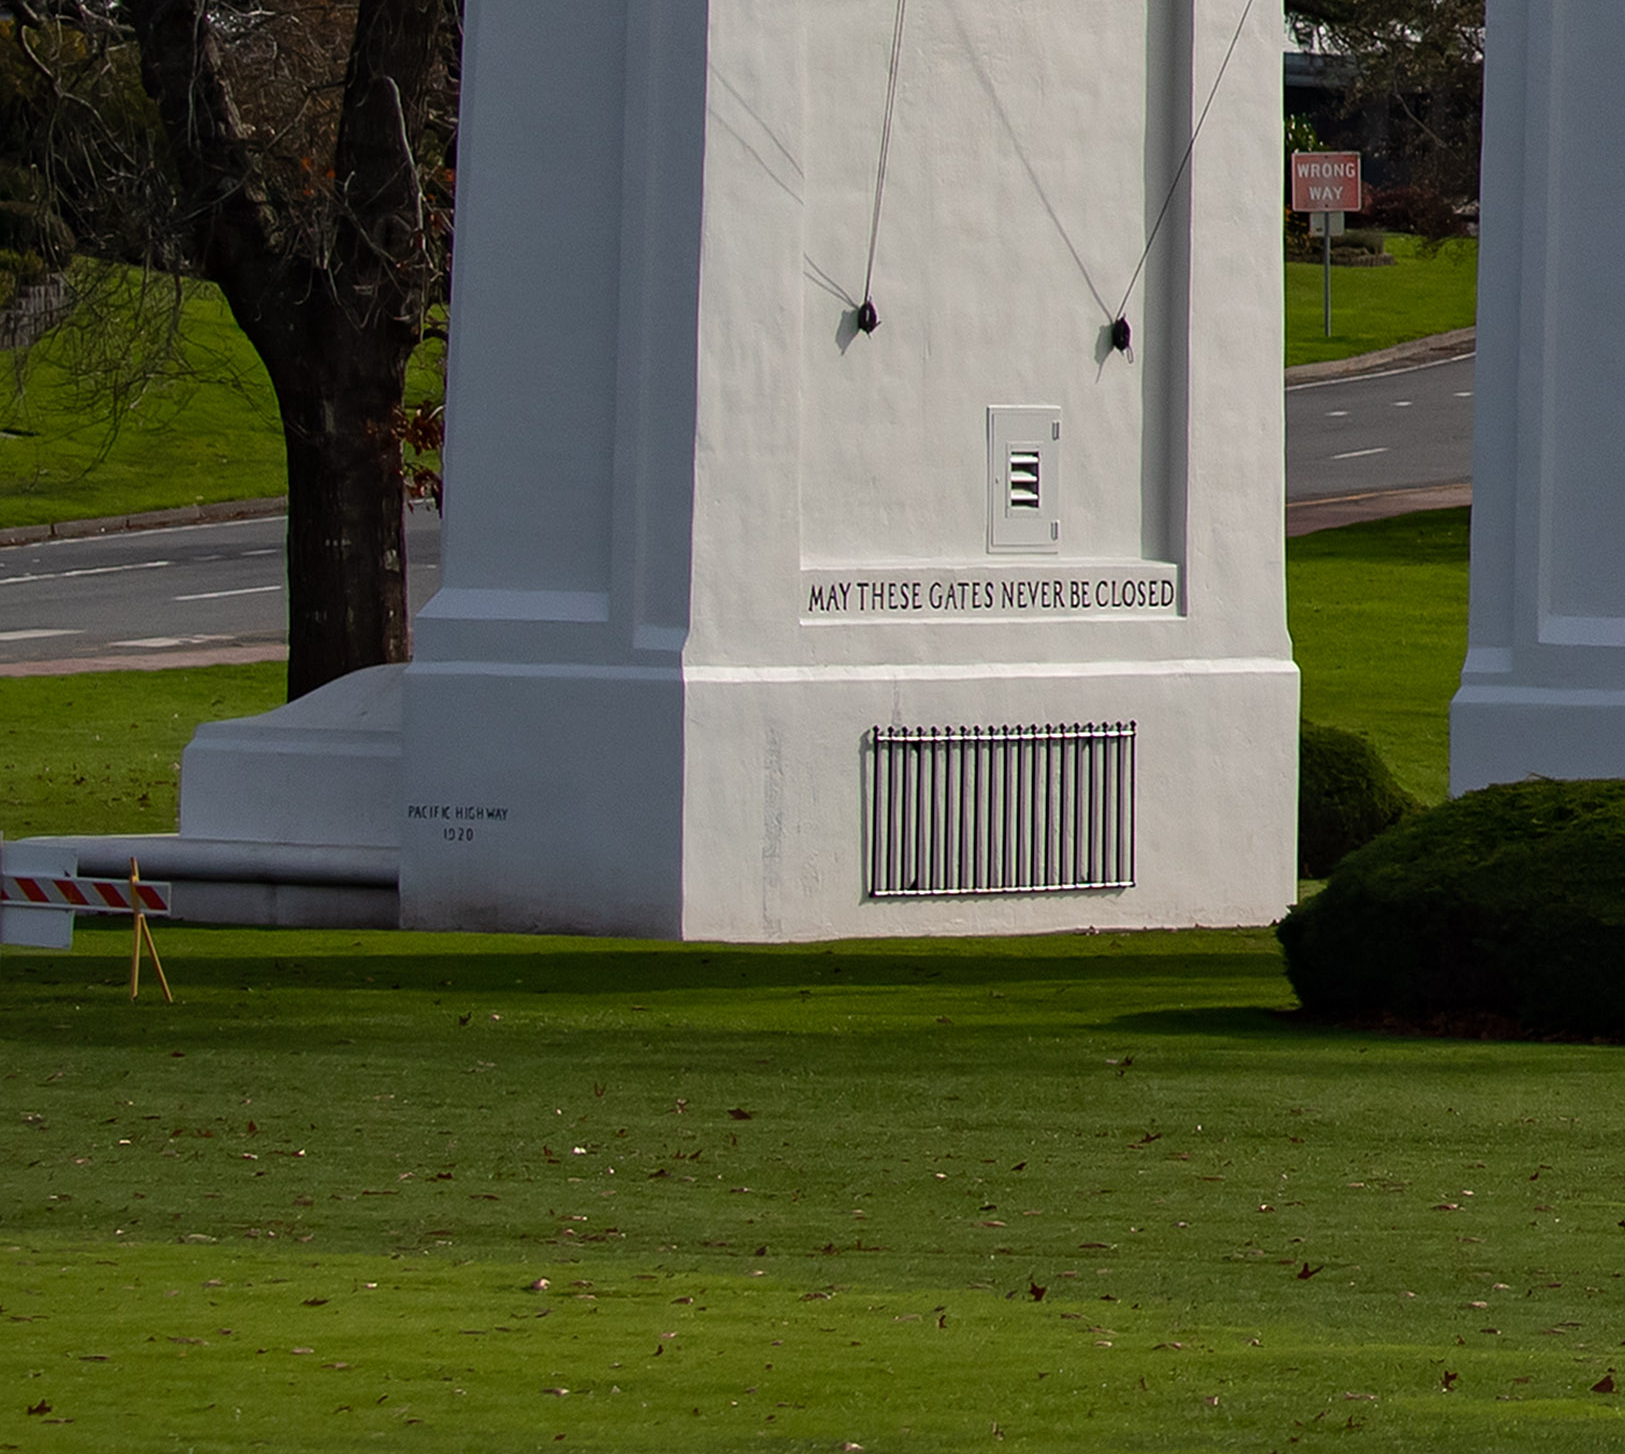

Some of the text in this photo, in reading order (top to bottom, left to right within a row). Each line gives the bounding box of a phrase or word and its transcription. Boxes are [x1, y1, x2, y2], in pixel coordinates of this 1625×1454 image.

[1297, 162, 1356, 179] WRONG
[1308, 186, 1344, 201] WAY
[808, 580, 1174, 611] MAY THESE GATES NEVER BE CLOSED
[407, 805, 508, 821] PACIFIC HIGHWAY
[443, 827, 474, 841] 1920
